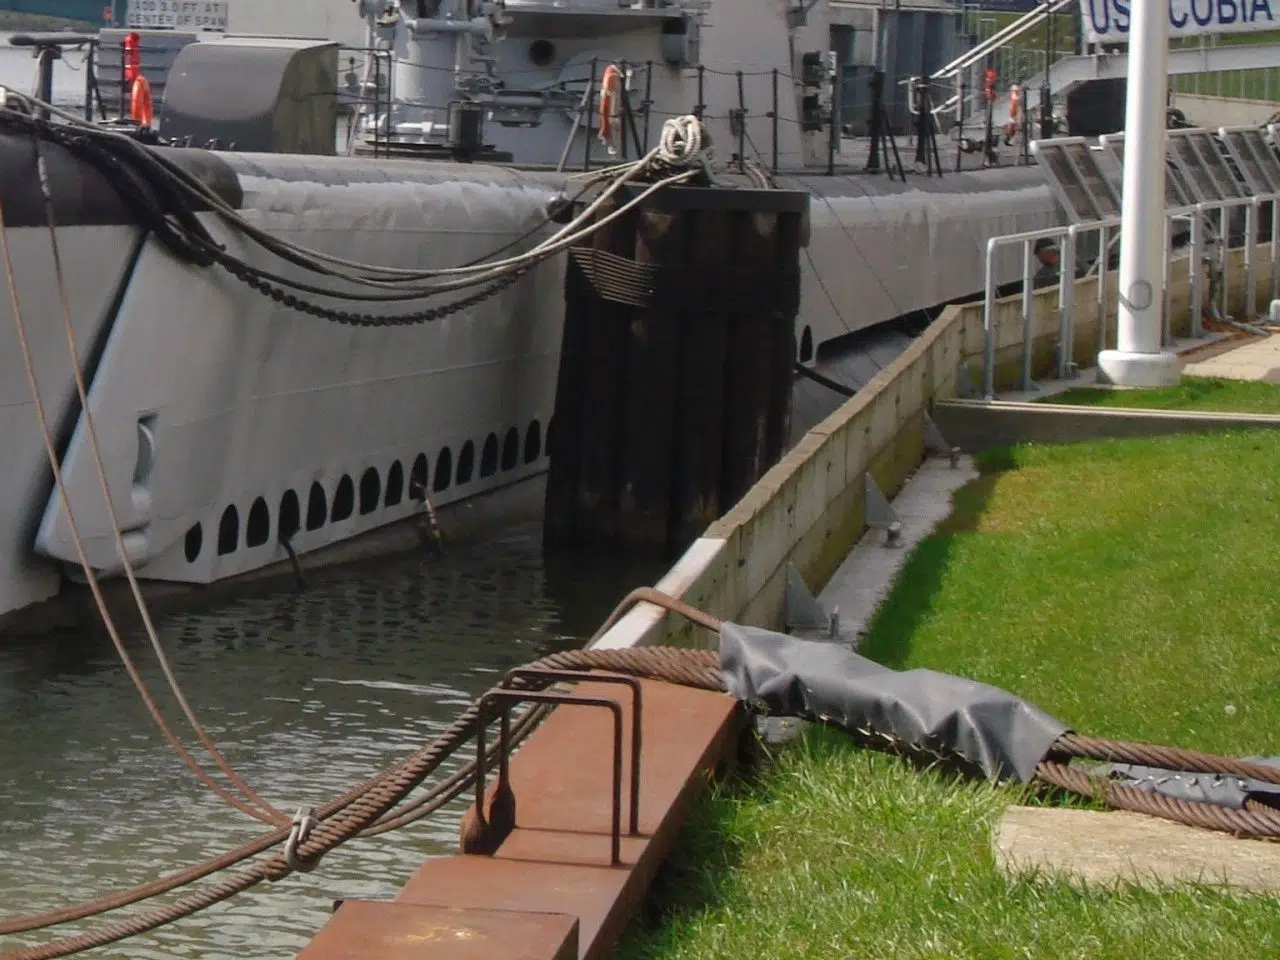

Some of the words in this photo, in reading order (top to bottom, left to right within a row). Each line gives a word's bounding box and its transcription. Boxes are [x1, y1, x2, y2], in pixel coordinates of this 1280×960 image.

[136, 1, 157, 11] ADD
[205, 3, 220, 13] AT
[129, 13, 172, 25] CENTER
[177, 15, 192, 26] OF
[195, 16, 226, 27] SPAN
